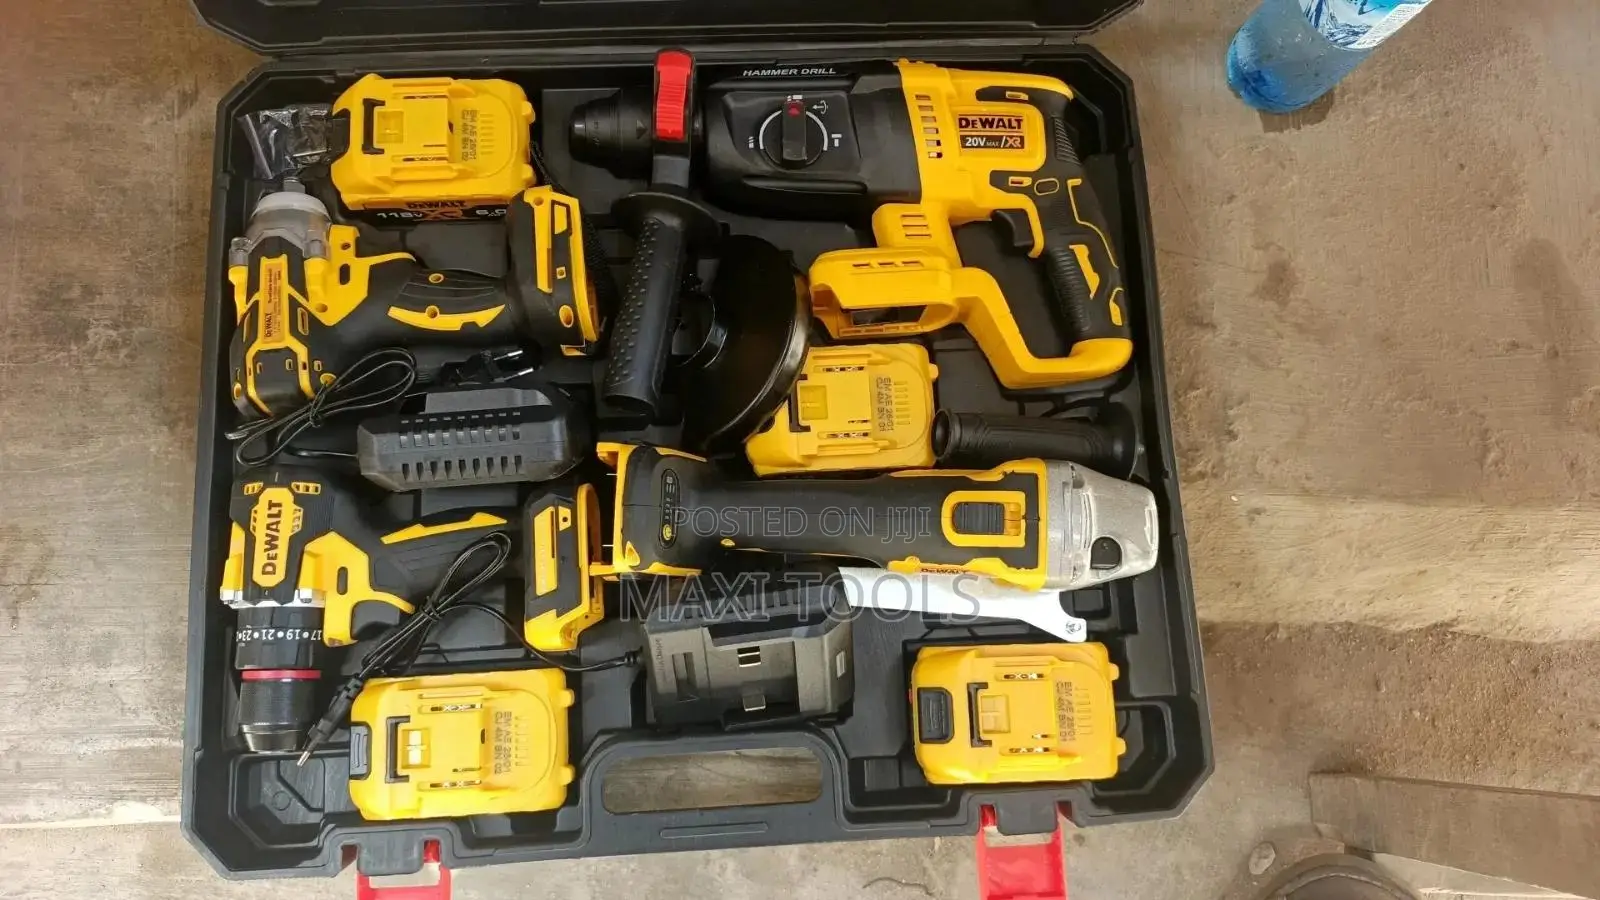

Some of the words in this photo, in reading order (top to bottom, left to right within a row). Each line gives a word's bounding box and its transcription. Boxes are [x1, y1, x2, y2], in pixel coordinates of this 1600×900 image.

[742, 68, 798, 77] HAMMER
[965, 137, 986, 147] 20V
[242, 630, 252, 642] 23
[261, 629, 276, 641] 21
[286, 629, 301, 640] 19
[311, 630, 322, 641] 17
